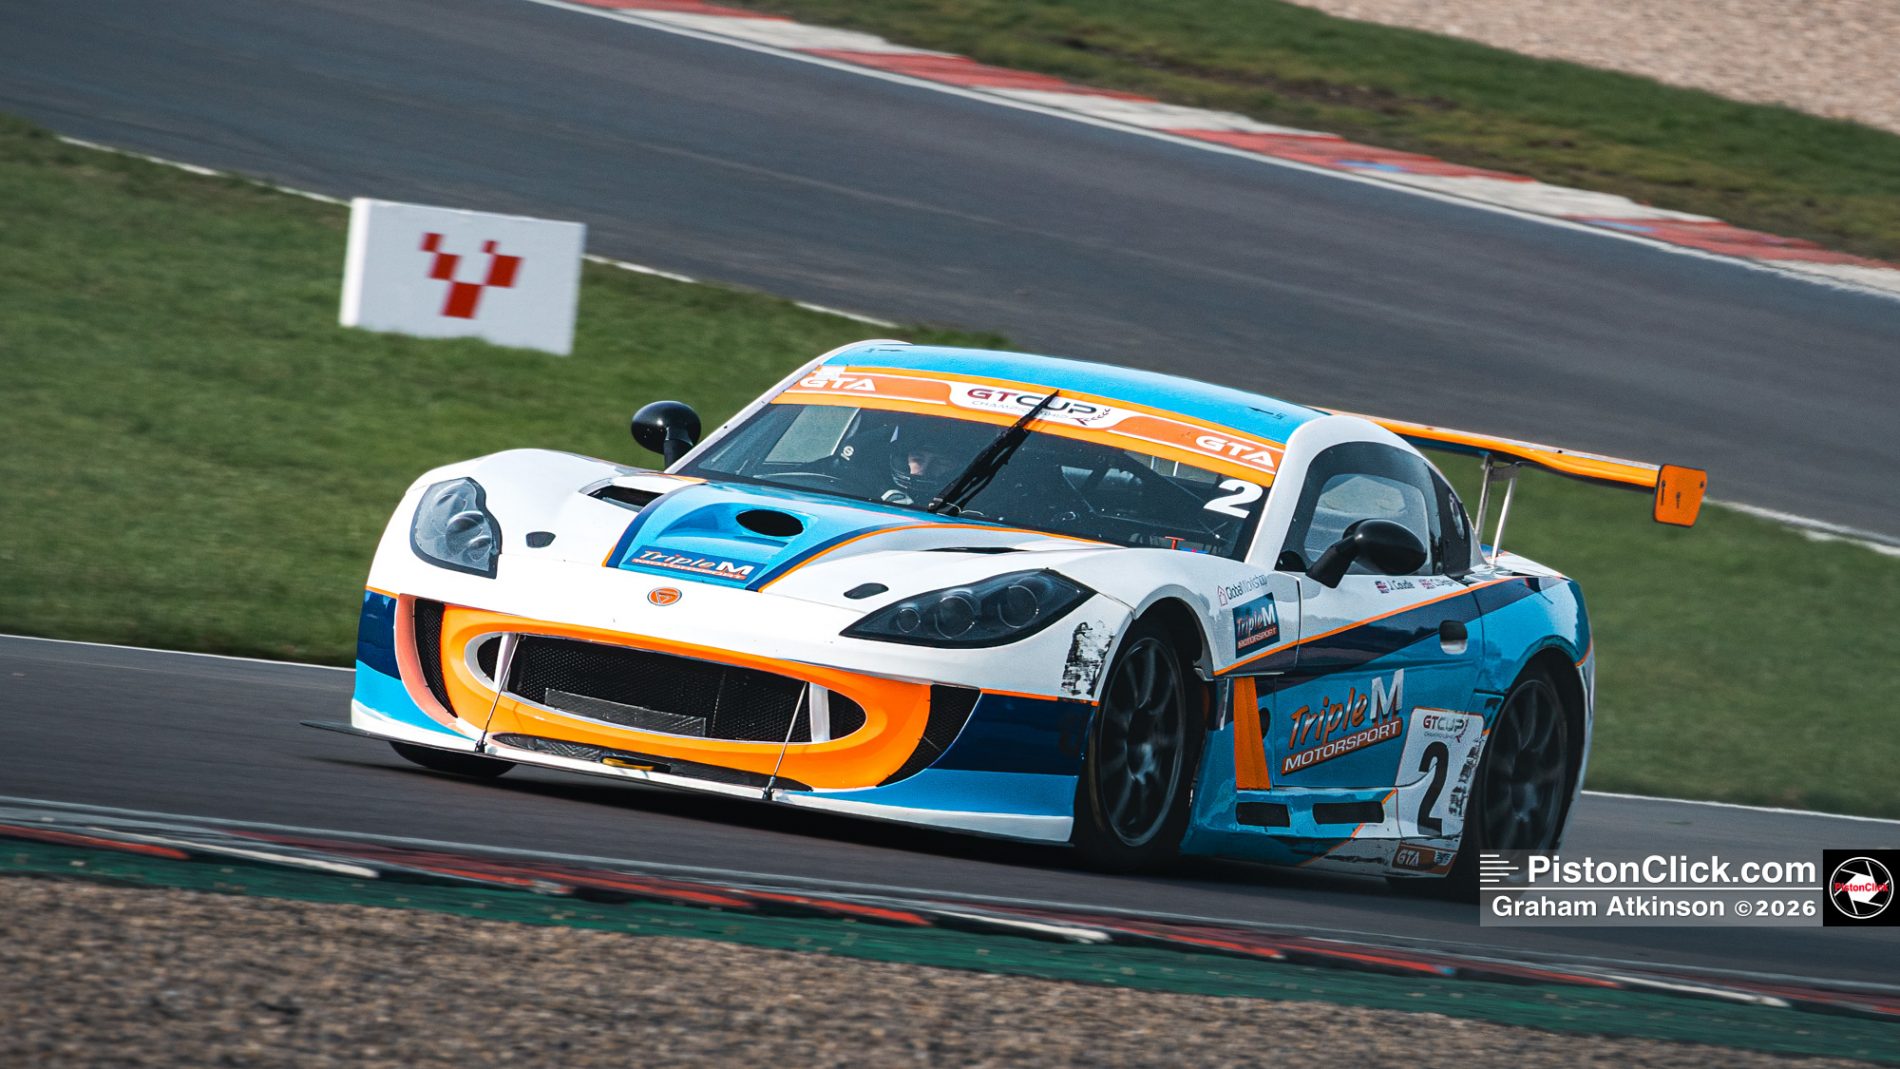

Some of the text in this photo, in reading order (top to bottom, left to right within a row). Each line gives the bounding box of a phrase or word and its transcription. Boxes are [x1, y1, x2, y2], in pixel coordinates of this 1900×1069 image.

[800, 376, 876, 392] GTA
[1196, 435, 1275, 468] GTA
[1203, 479, 1263, 519] 2
[1285, 720, 1400, 772] MOTORSPORT
[1417, 741, 1449, 836] 2
[1397, 849, 1420, 866] GTA
